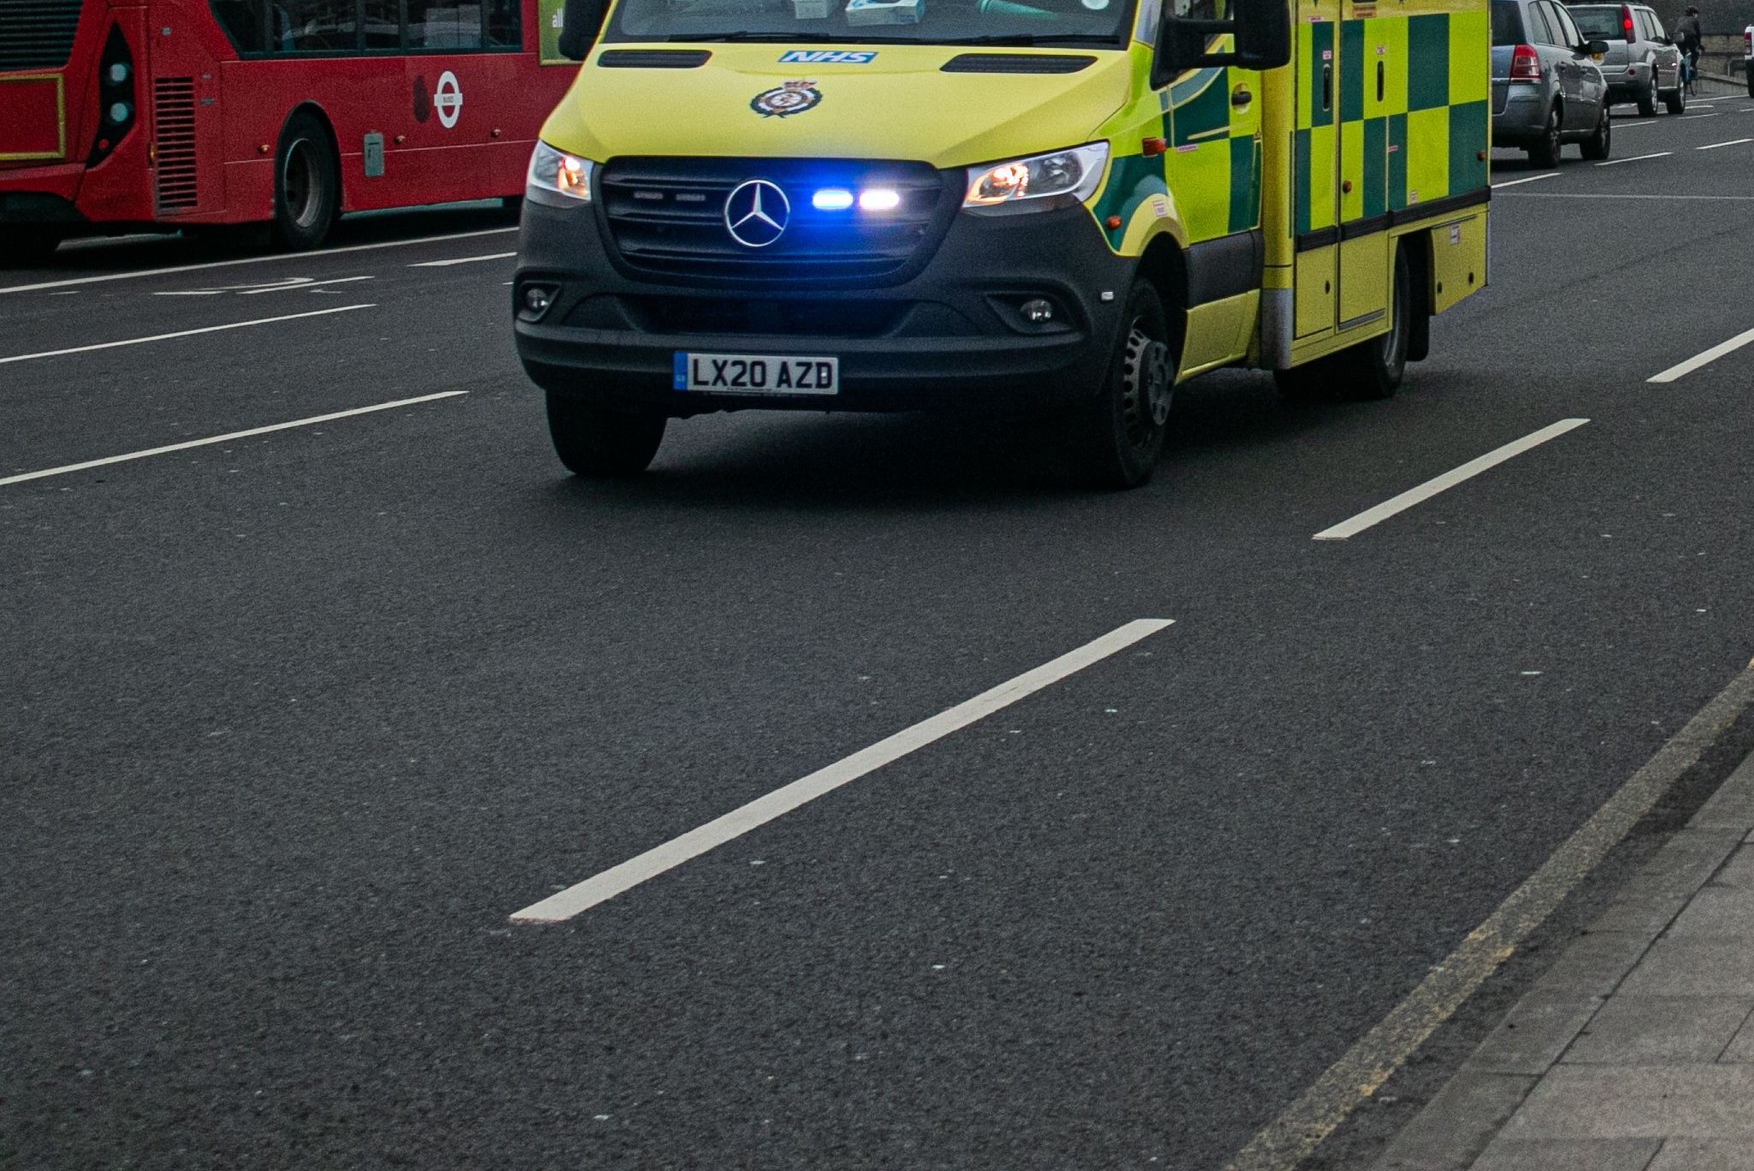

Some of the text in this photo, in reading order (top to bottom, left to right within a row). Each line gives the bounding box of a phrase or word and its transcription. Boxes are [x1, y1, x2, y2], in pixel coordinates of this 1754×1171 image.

[781, 52, 875, 62] NHS
[693, 358, 833, 389] LX20 AZD
